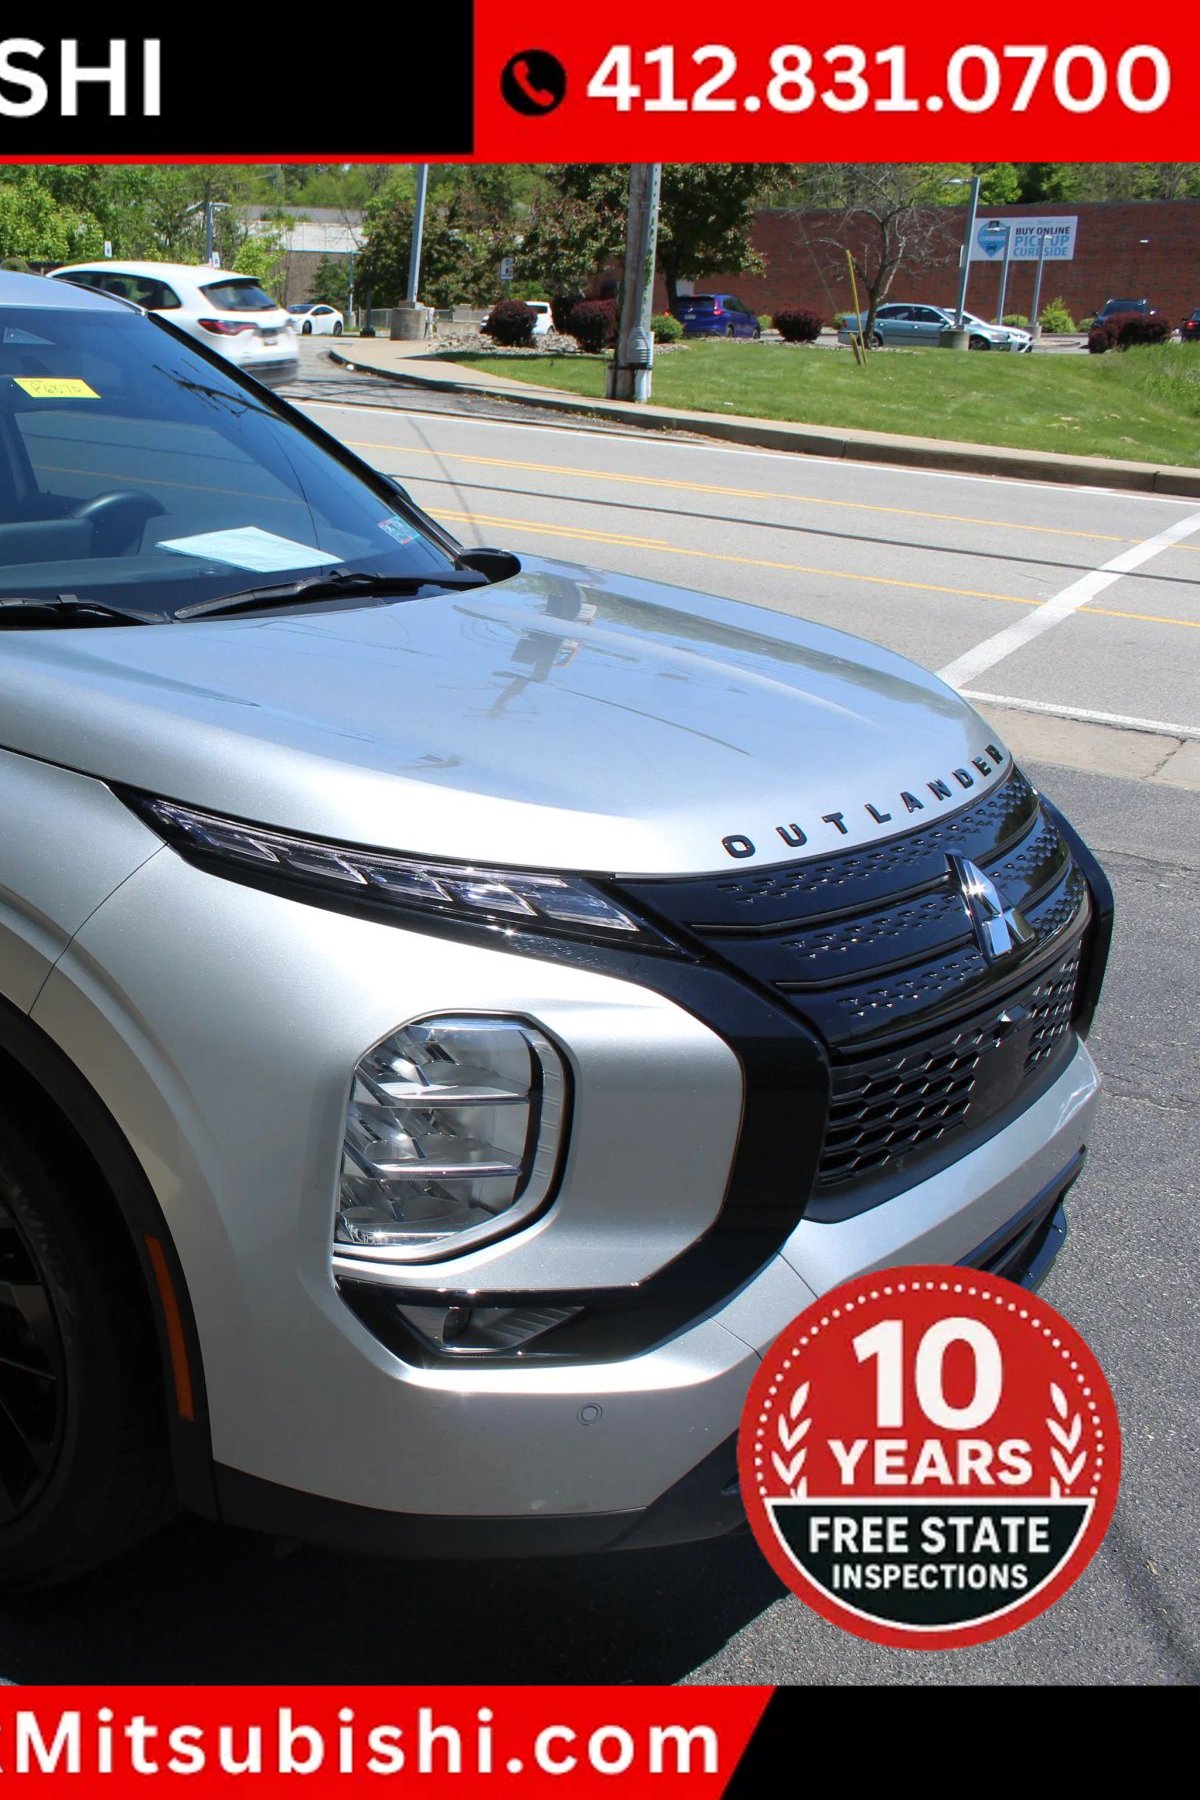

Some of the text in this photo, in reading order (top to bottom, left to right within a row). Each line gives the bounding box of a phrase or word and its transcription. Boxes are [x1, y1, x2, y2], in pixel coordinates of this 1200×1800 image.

[1015, 226, 1071, 236] BUY ONLINE
[721, 743, 1005, 859] OUTLANDER
